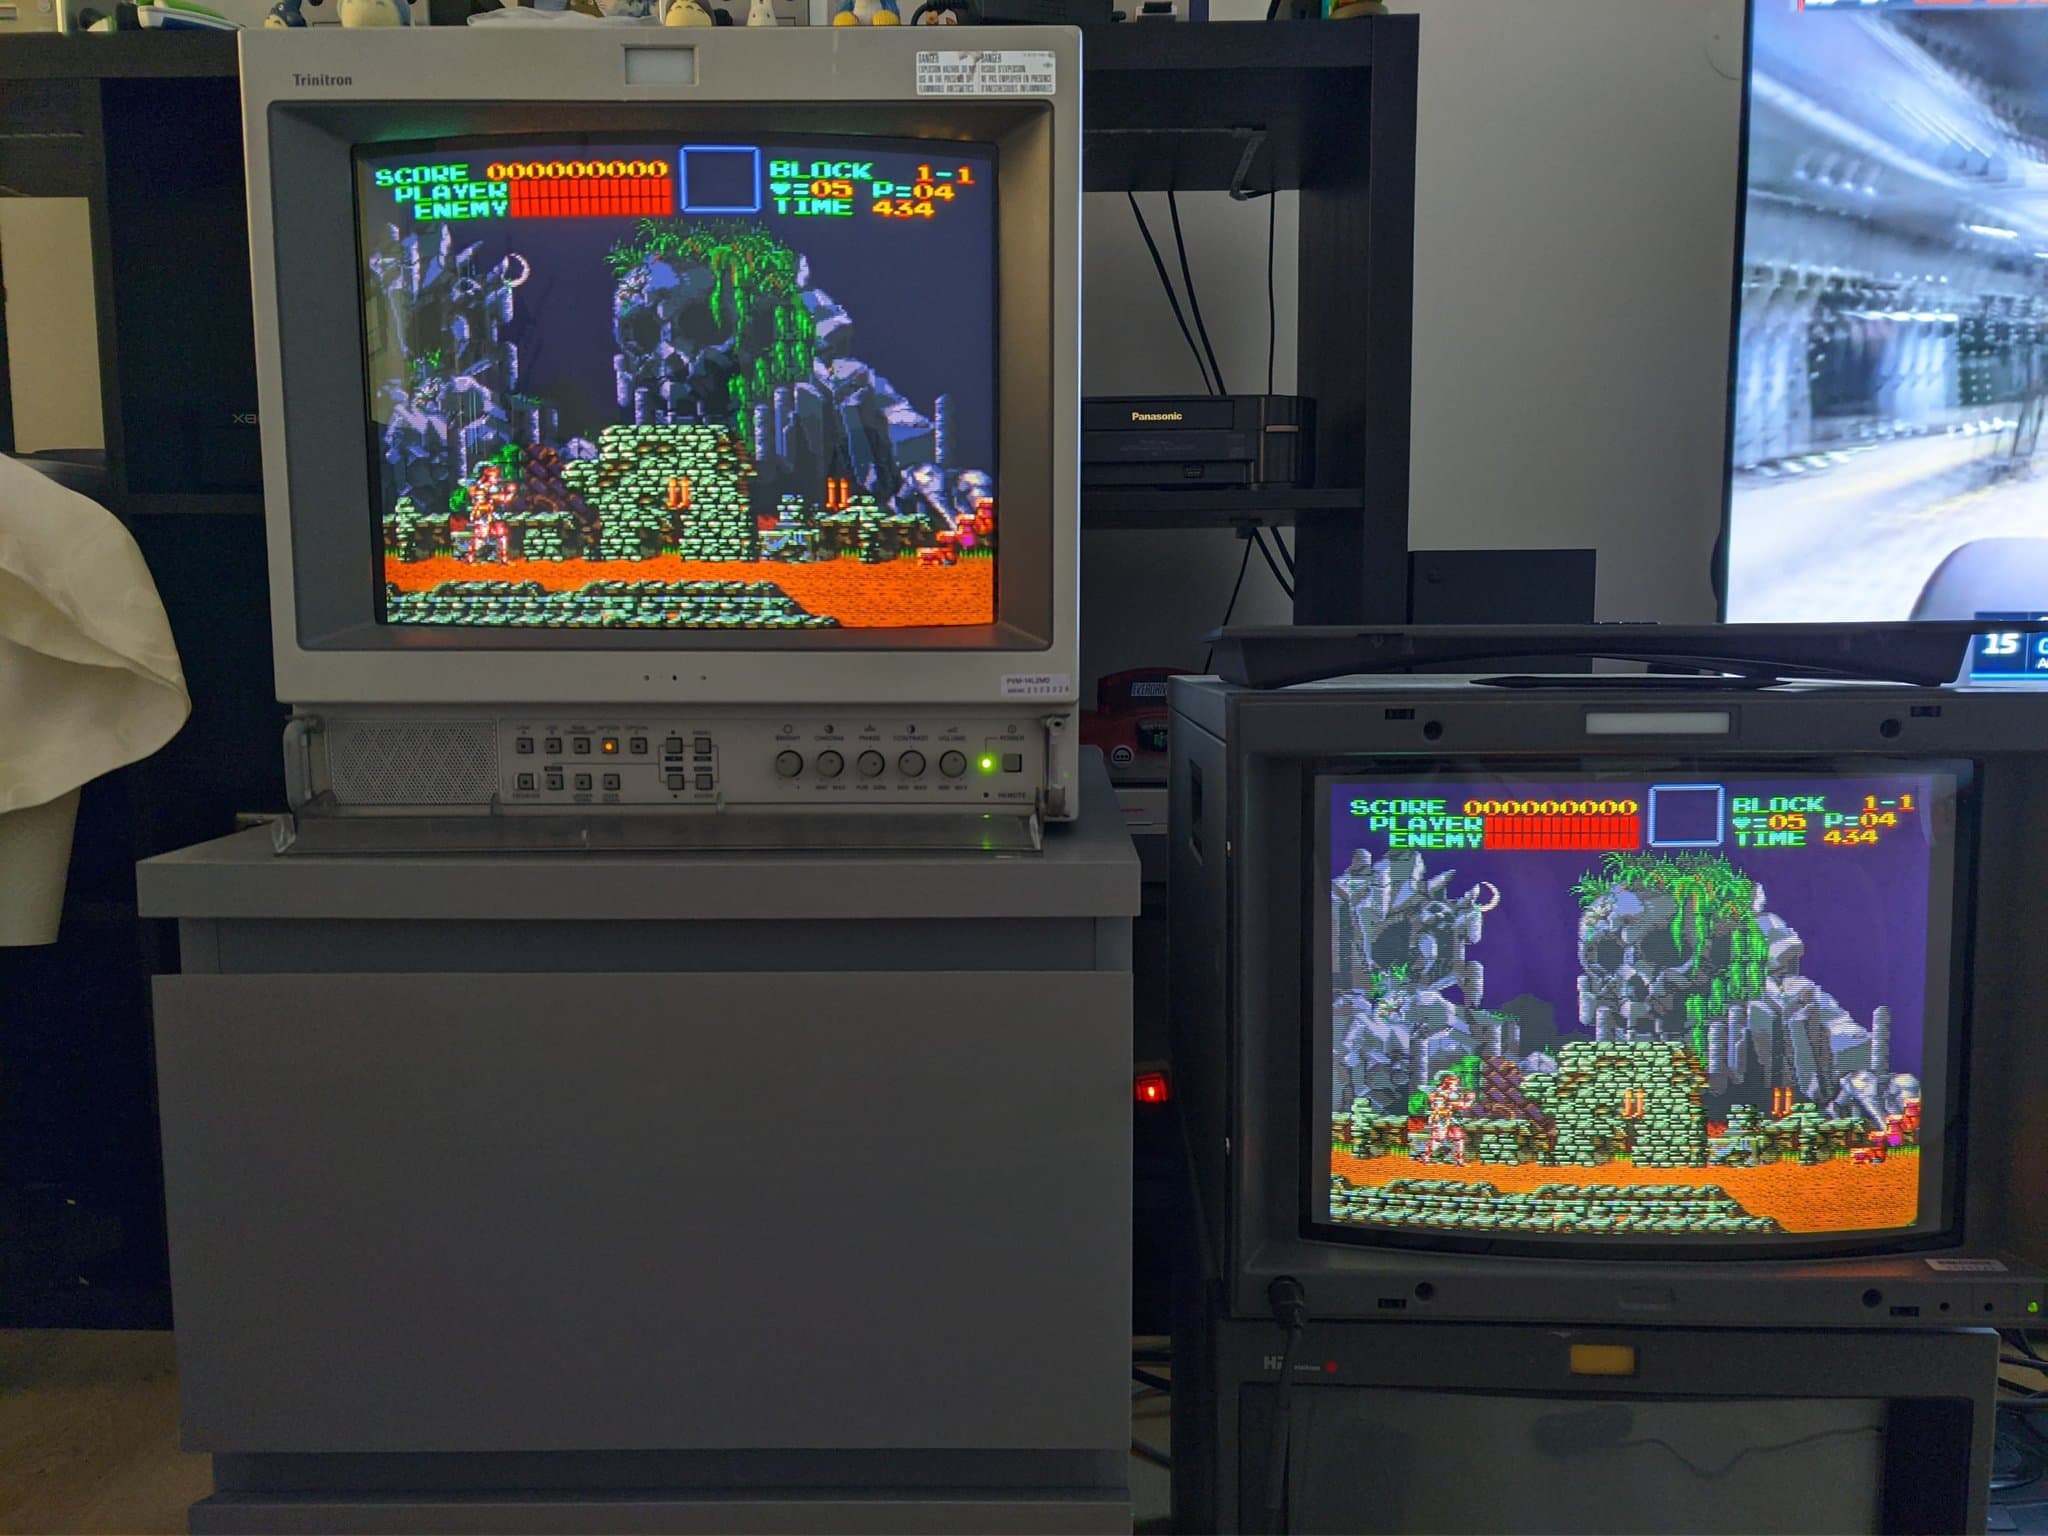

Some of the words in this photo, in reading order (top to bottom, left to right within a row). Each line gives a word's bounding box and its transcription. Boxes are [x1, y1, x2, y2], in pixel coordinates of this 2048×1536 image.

[292, 73, 352, 86] Trinitron
[375, 163, 469, 187] SCORE
[486, 160, 669, 181] 000000000
[769, 160, 874, 181] BLOCK
[916, 163, 975, 185] 1-1
[394, 181, 509, 204] PLAYER
[872, 180, 956, 202] P=04
[414, 200, 509, 221] ENEMY
[773, 196, 854, 217] TIME
[871, 198, 936, 219] 434
[1131, 411, 1183, 422] Panasonic
[1981, 633, 2019, 654] 15
[1350, 799, 1447, 816] SCORE
[1463, 799, 1638, 816] 000000000
[1732, 796, 1826, 814] BLOCK
[1862, 794, 1915, 811] 1-1
[1369, 815, 1483, 832] PLAYER
[1824, 812, 1897, 829] P=04
[1389, 831, 1483, 848] ENEMY
[1734, 829, 1807, 848] TIME
[1823, 829, 1878, 846] 434
